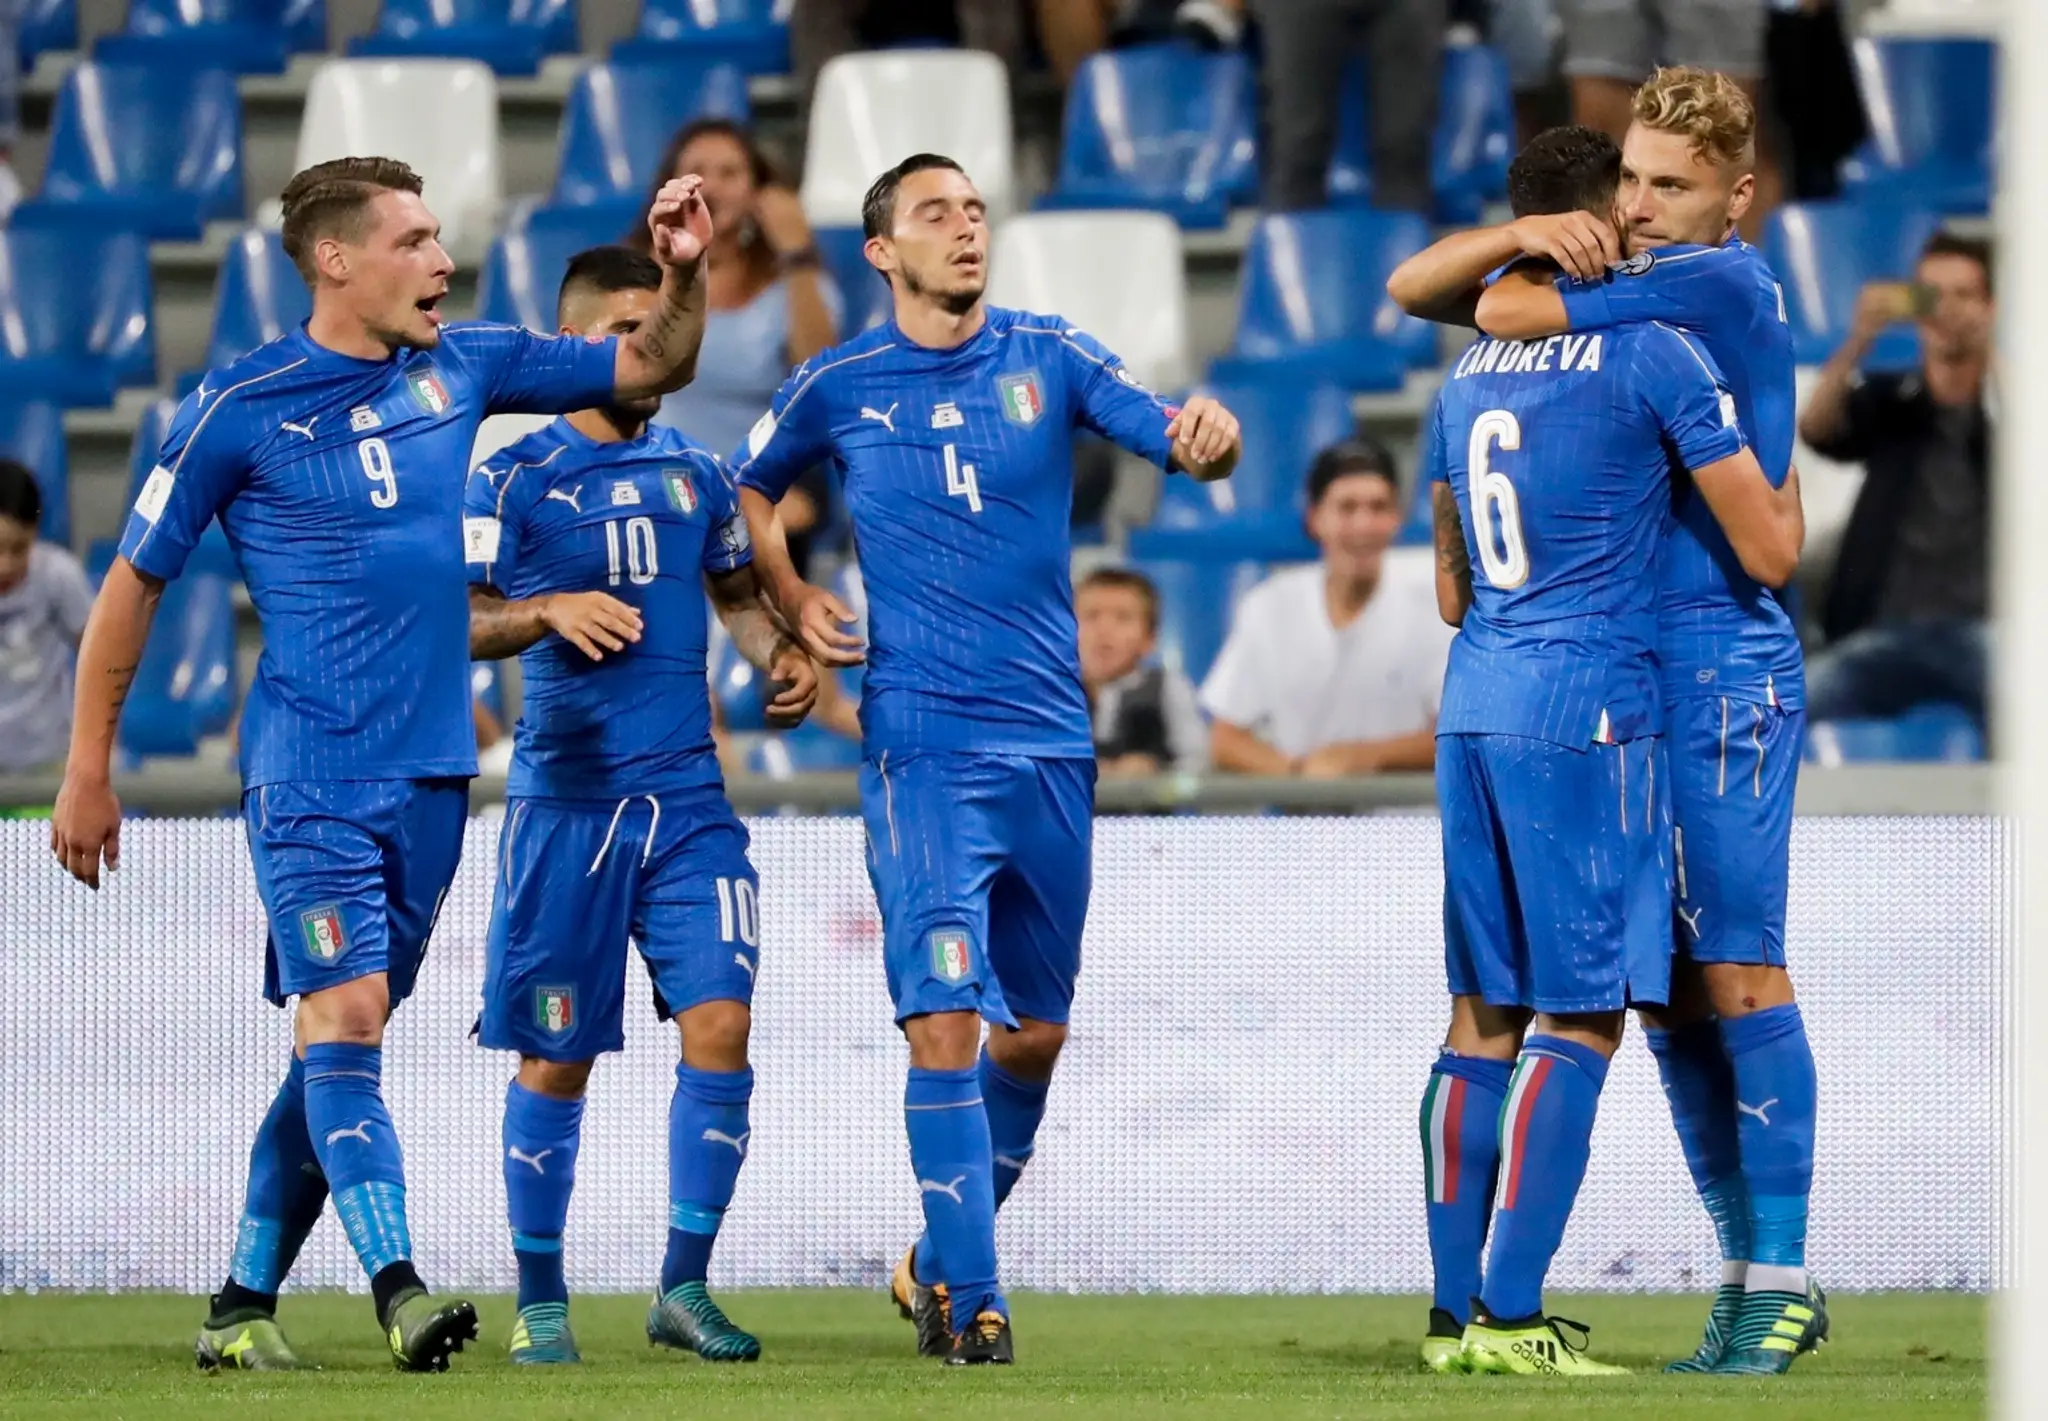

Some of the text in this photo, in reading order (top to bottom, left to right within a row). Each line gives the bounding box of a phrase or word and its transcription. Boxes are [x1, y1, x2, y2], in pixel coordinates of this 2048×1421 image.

[1454, 334, 1602, 380] CANDREVA
[358, 438, 398, 509] 9
[943, 443, 983, 513] 4
[1468, 409, 1530, 590] 6
[605, 516, 658, 586] 10
[716, 877, 760, 947] 10
